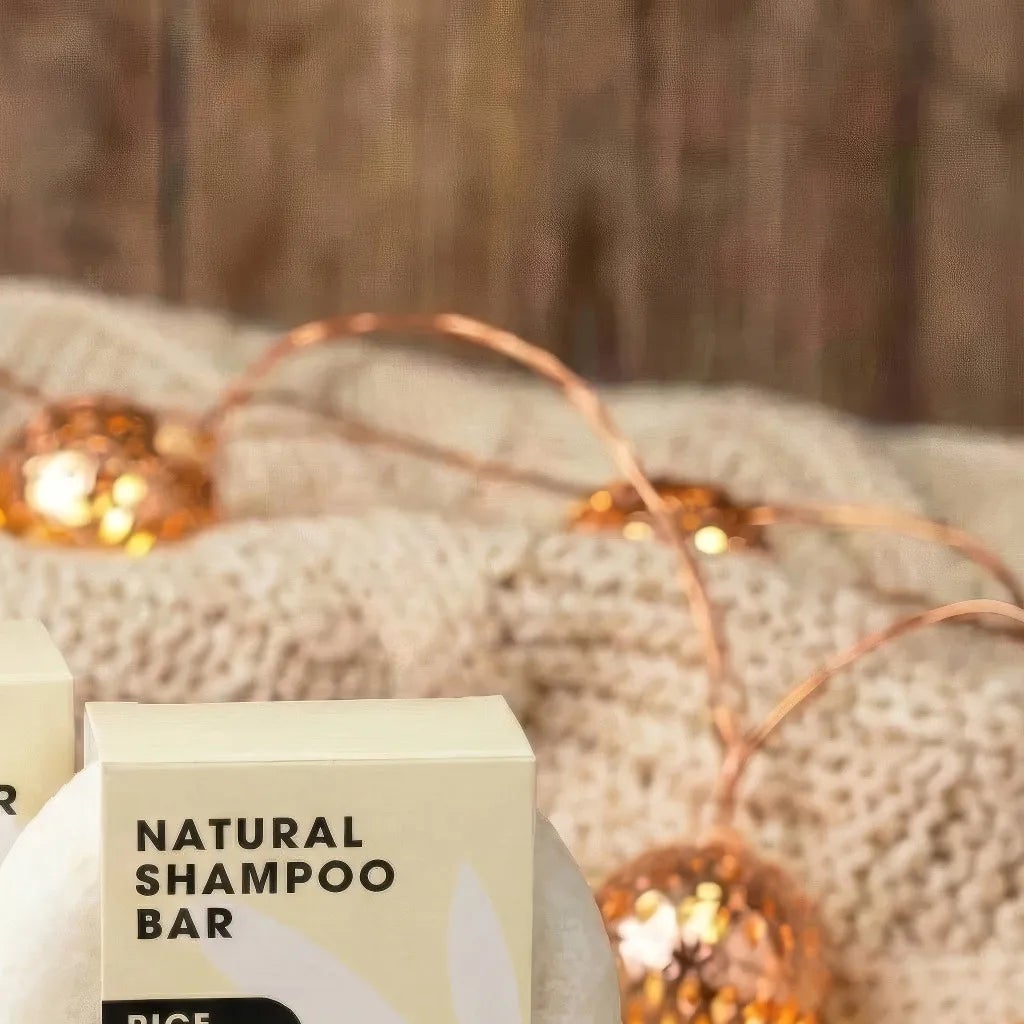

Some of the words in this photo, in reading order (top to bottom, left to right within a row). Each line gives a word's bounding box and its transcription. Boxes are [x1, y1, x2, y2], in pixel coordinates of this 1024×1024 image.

[136, 815, 363, 852] NATURAL
[135, 858, 395, 896] SHAMPOO
[136, 907, 233, 940] BAR
